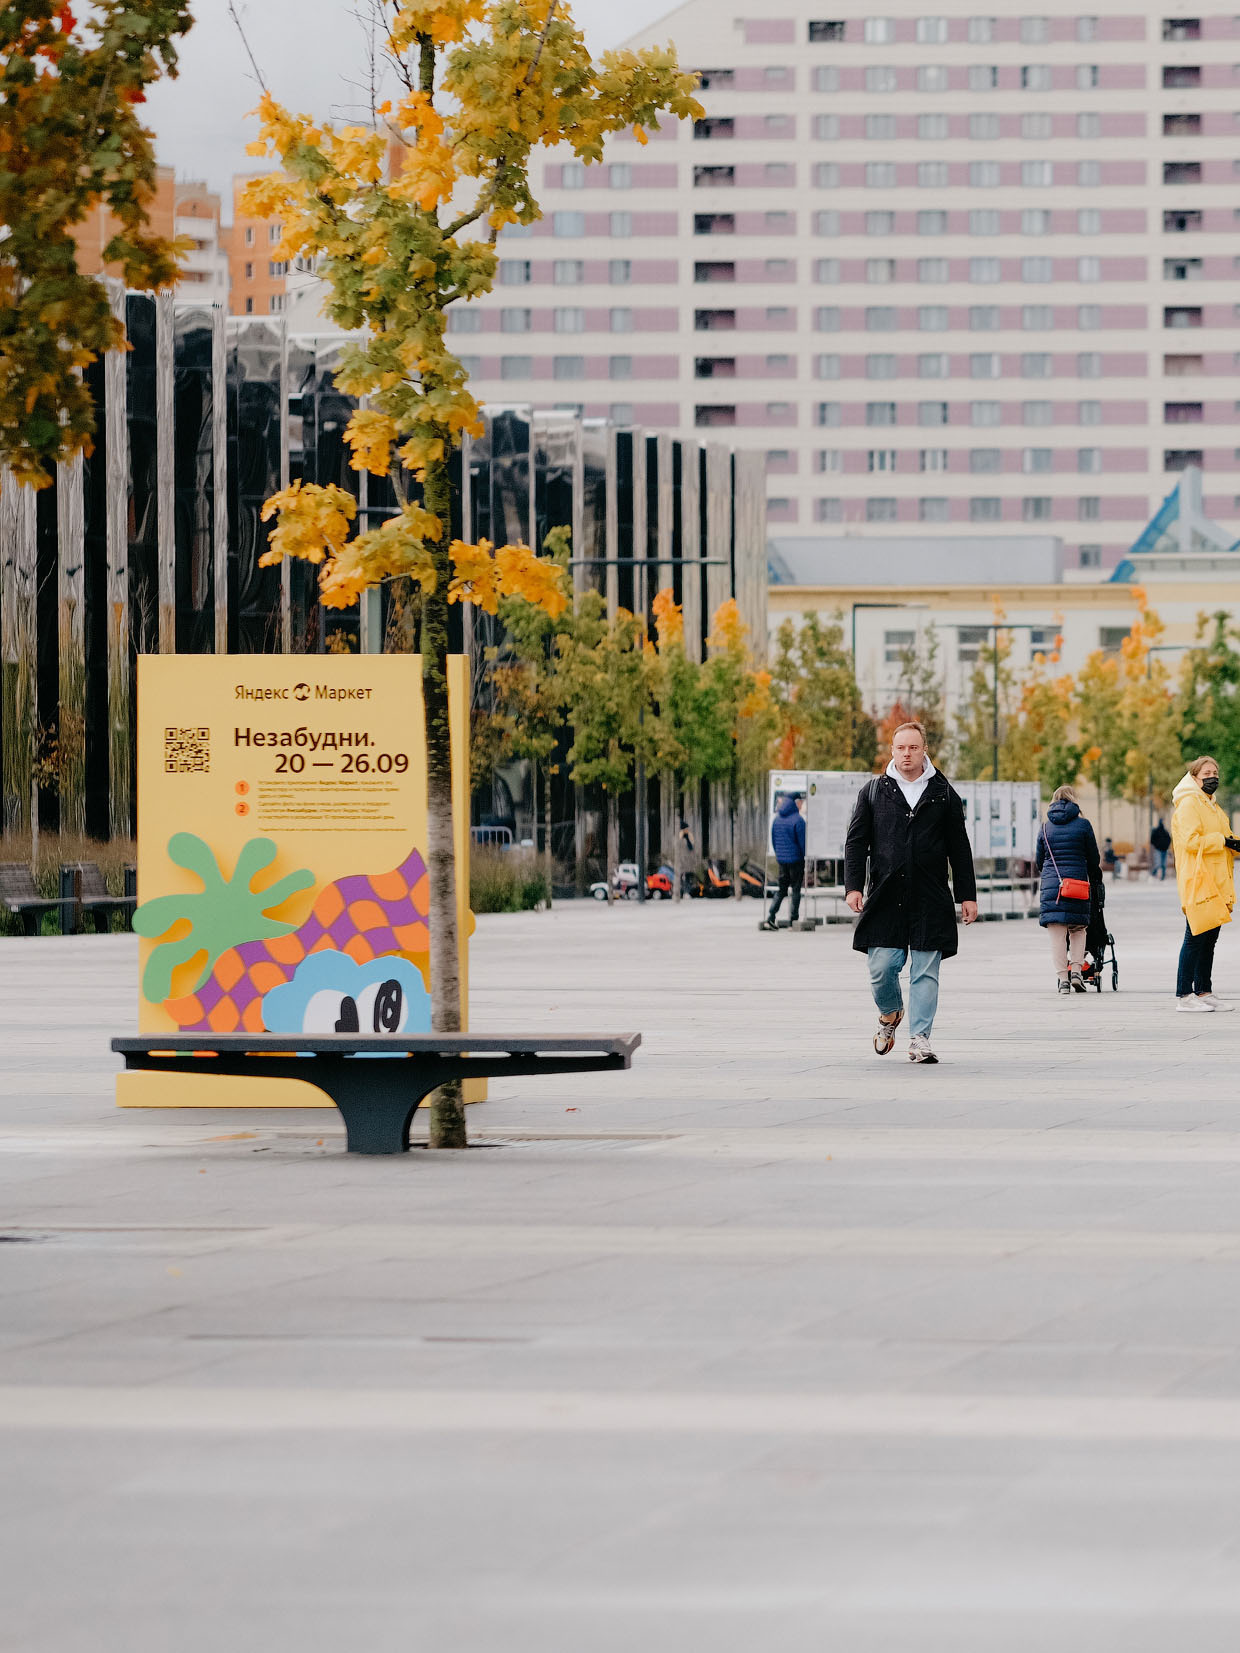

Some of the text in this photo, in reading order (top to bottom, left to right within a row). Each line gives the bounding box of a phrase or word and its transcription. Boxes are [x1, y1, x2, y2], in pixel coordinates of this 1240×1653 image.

[235, 685, 372, 702] Яндекс Маркет
[234, 727, 375, 751] Незабудни.
[275, 753, 305, 773] 20
[341, 753, 409, 773] 26.09
